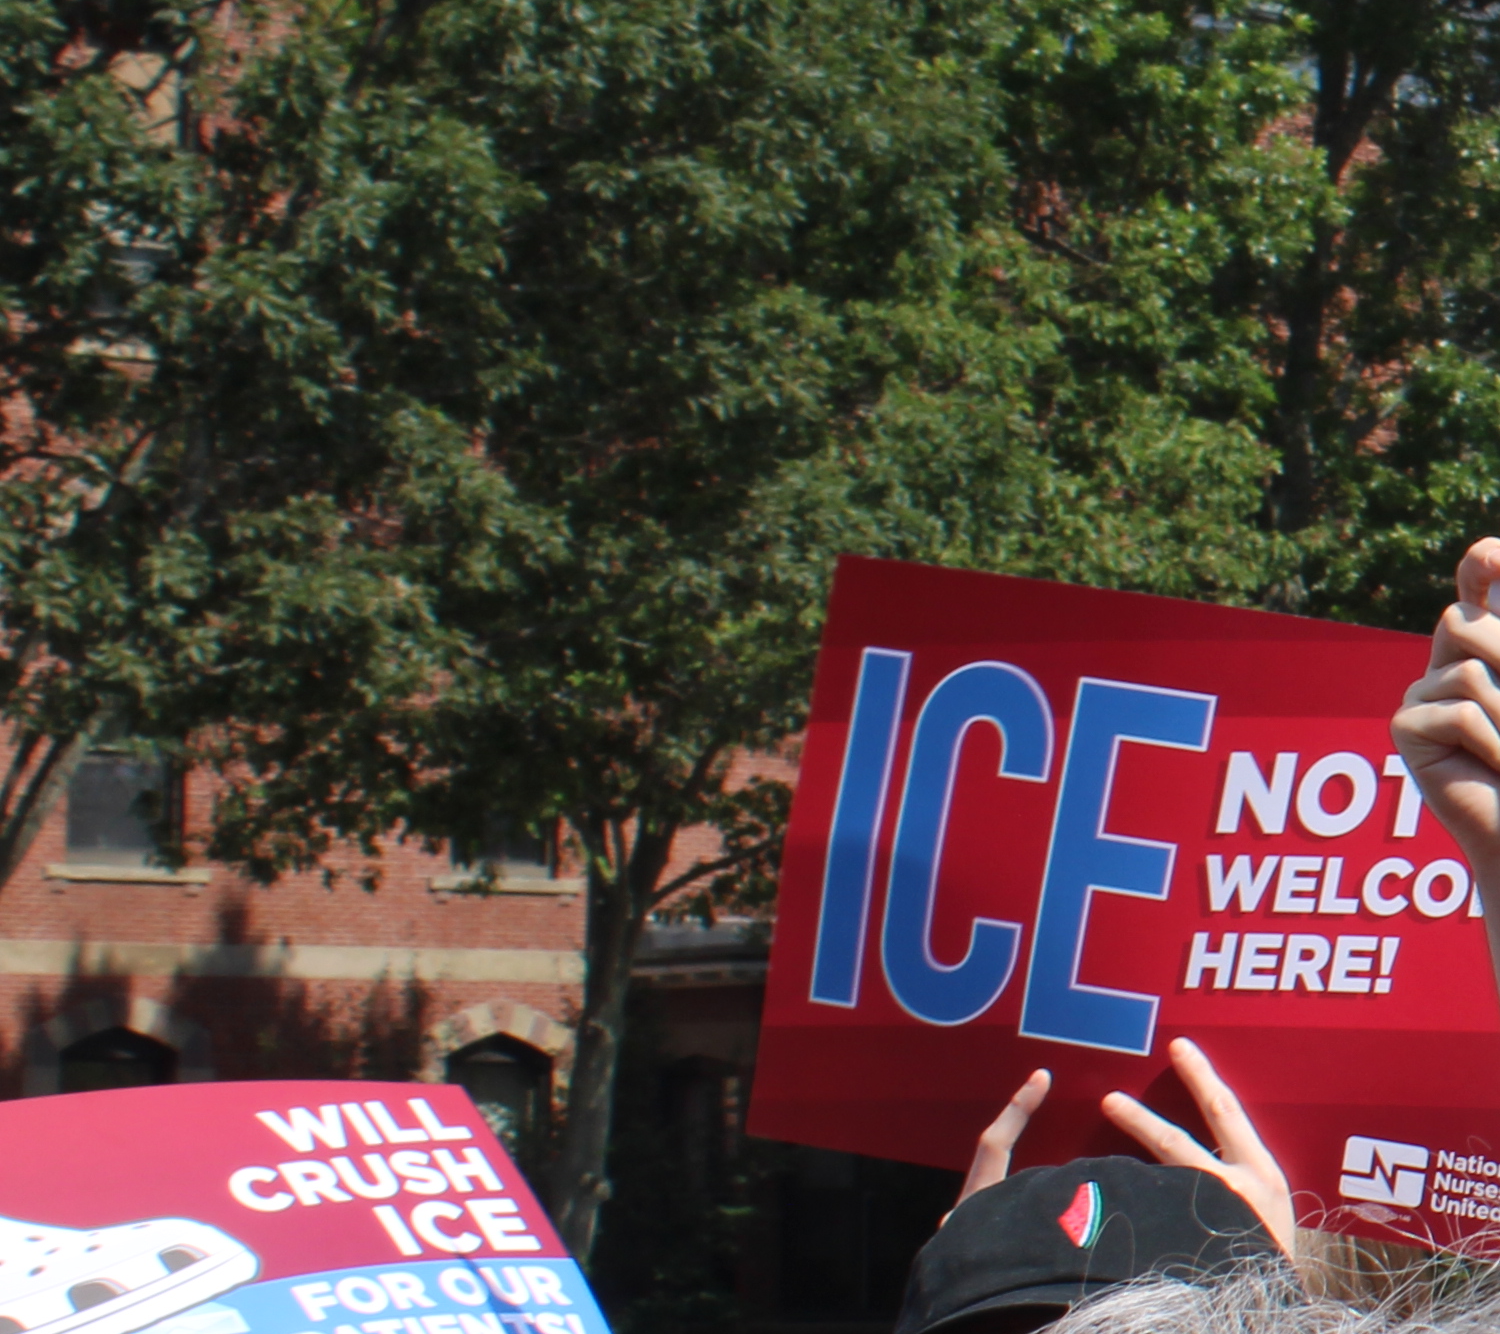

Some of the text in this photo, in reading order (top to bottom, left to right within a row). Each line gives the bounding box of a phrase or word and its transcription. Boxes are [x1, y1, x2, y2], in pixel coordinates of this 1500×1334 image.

[809, 646, 1218, 1057] ICE
[1204, 855, 1484, 919] WELCO
[1183, 931, 1400, 995] HERE!
[256, 1098, 472, 1153] WILL
[228, 1146, 505, 1213] CRUSH
[372, 1198, 543, 1258] ICE
[290, 1267, 572, 1322] FOR OUR
